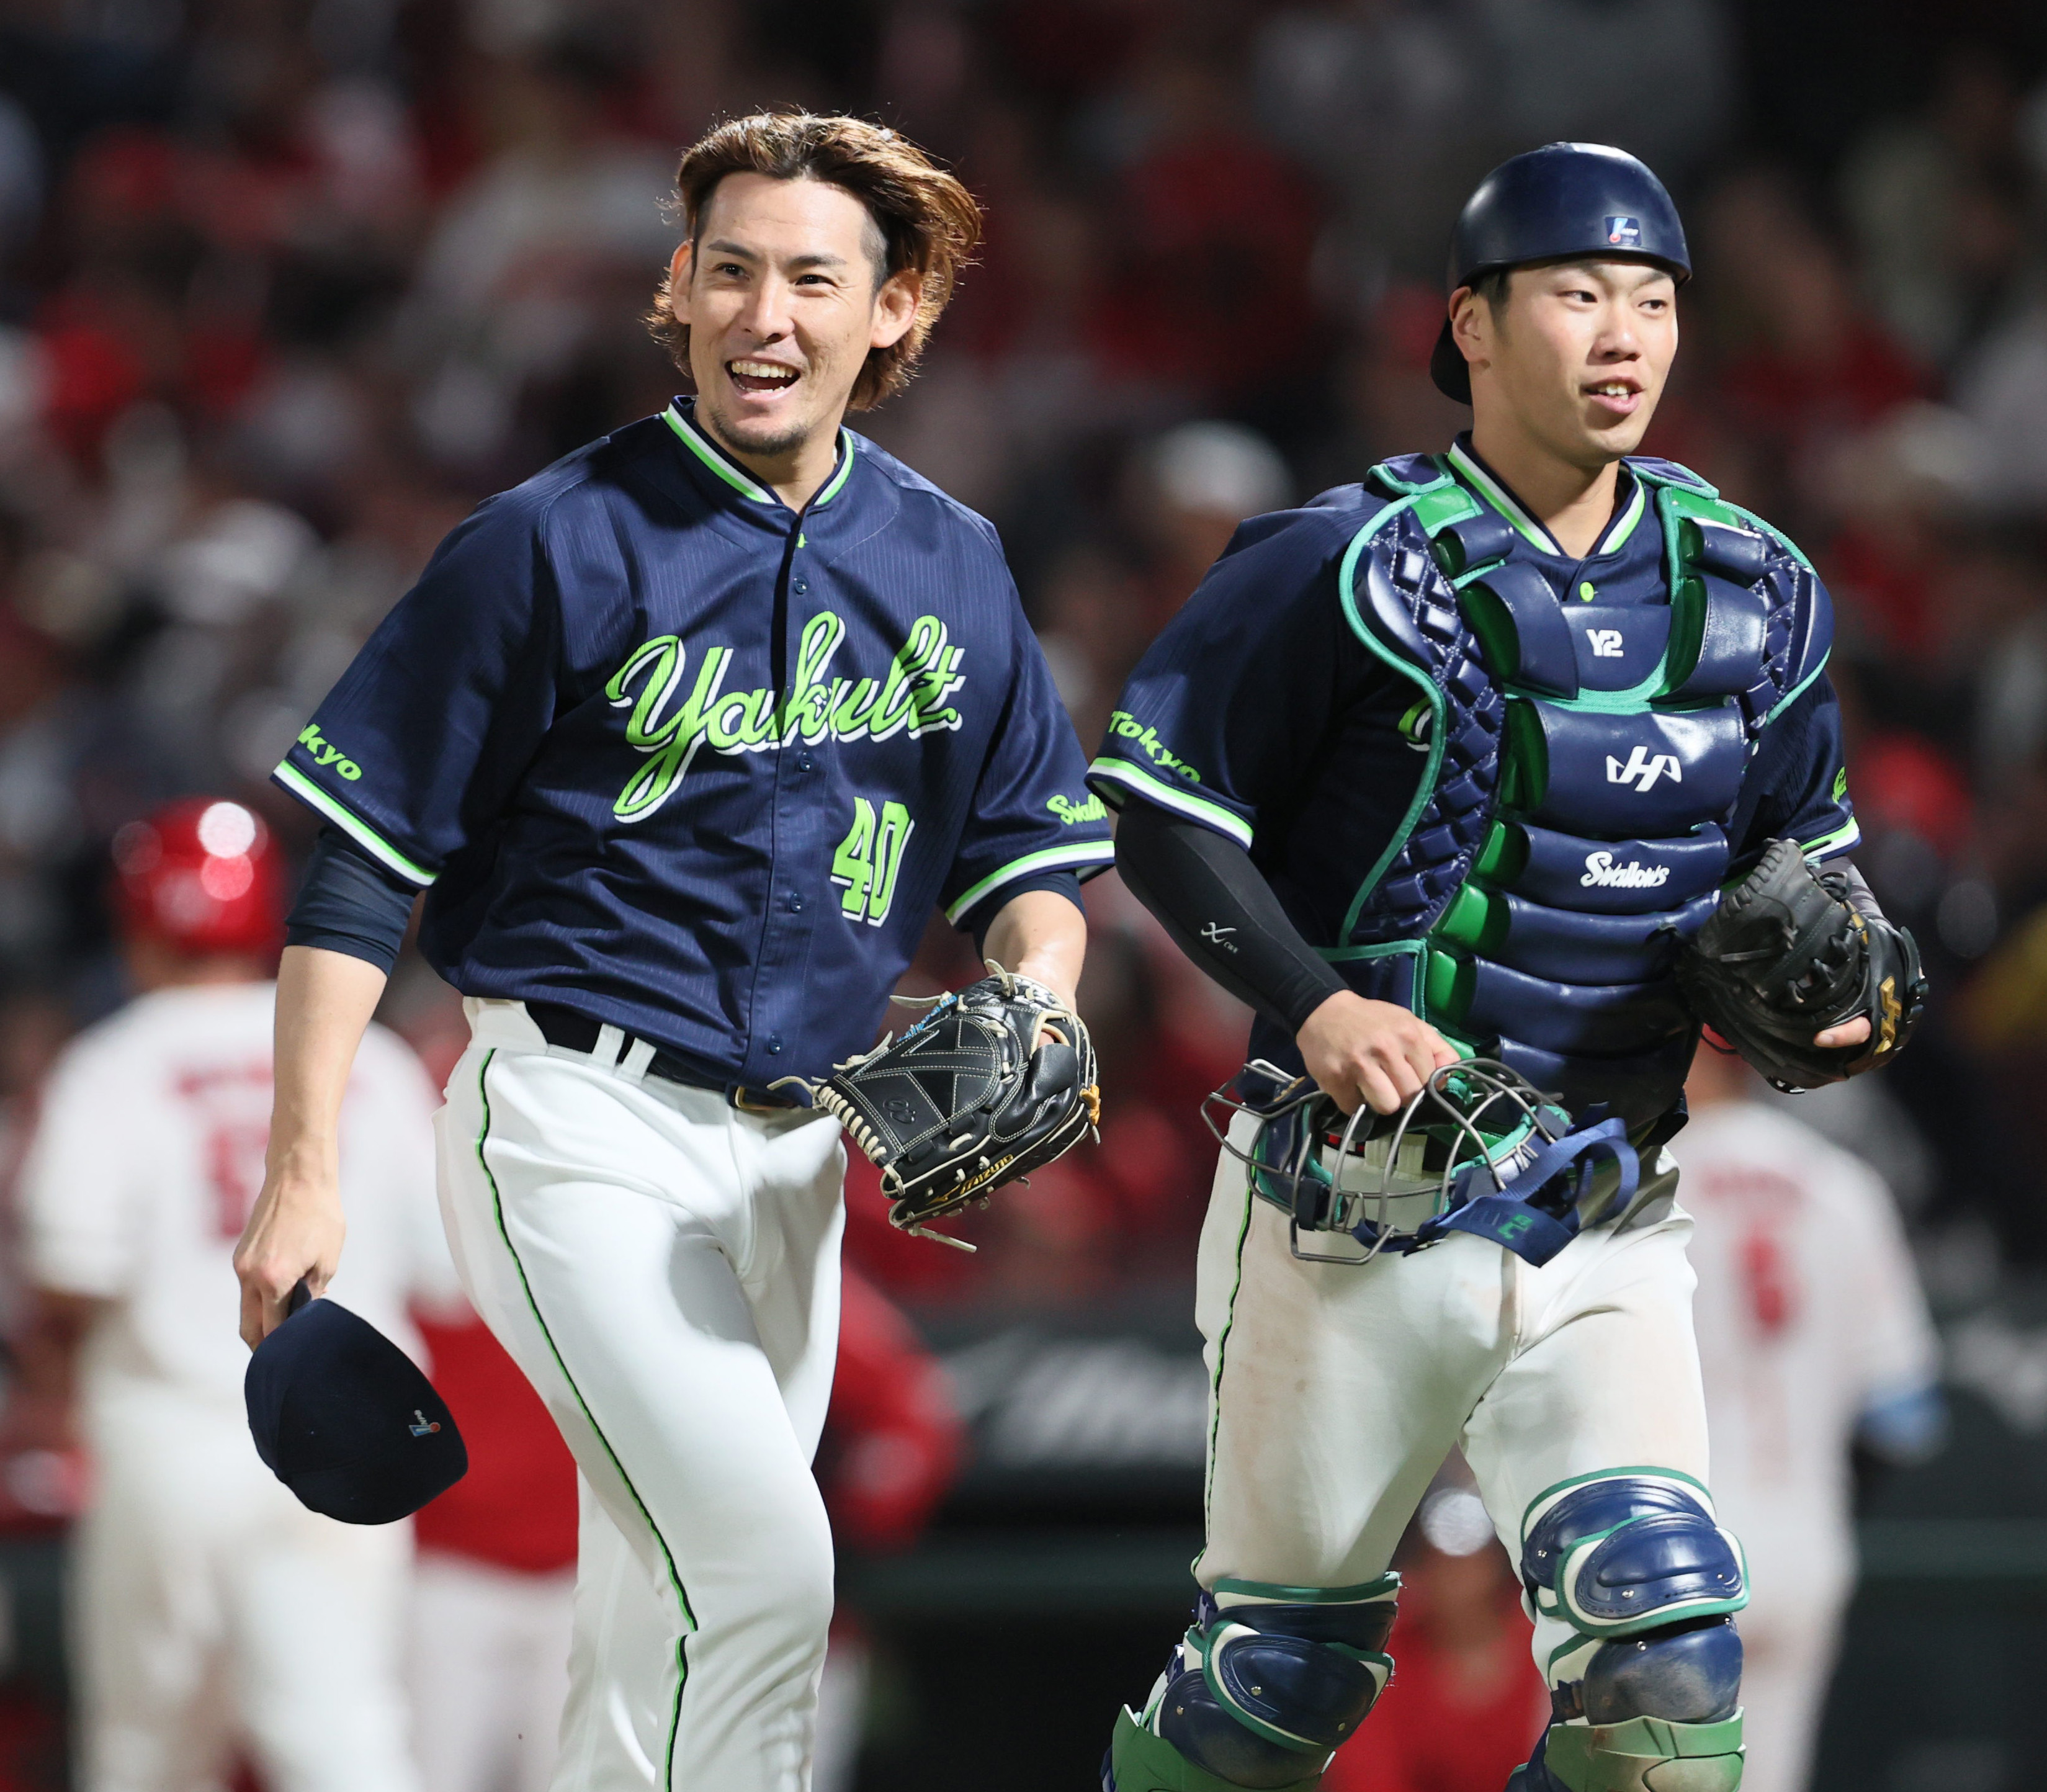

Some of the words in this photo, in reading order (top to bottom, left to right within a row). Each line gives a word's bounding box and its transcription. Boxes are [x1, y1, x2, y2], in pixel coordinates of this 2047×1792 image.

[1586, 629, 1624, 657] Y2
[605, 611, 967, 823] Yakult
[1108, 710, 1201, 782] Tokyo
[830, 796, 915, 927] 40
[1580, 851, 1670, 888] Swallows
